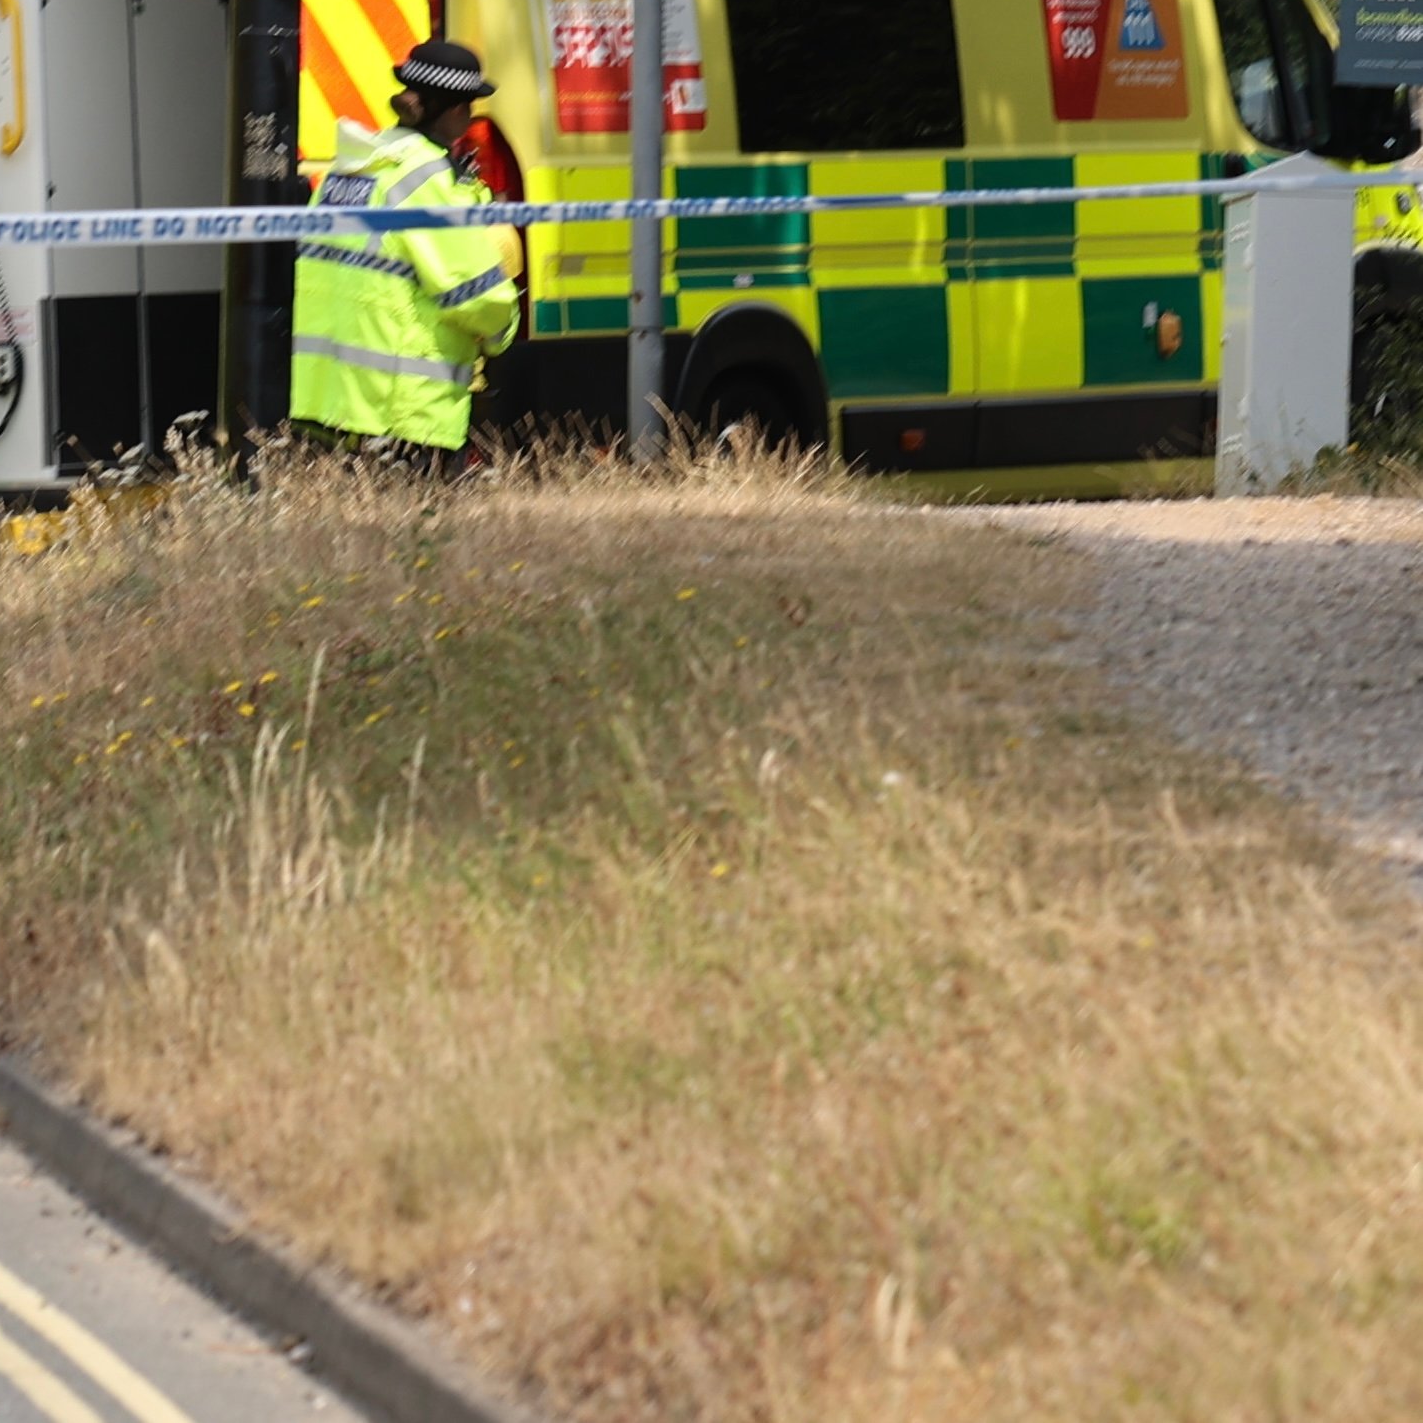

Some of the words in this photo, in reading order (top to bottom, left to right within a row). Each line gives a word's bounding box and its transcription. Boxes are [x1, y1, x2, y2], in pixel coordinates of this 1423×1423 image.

[91, 218, 145, 242] LINE
[156, 217, 187, 240] DO
[196, 216, 246, 239] NOT
[254, 213, 335, 237] CROSS
